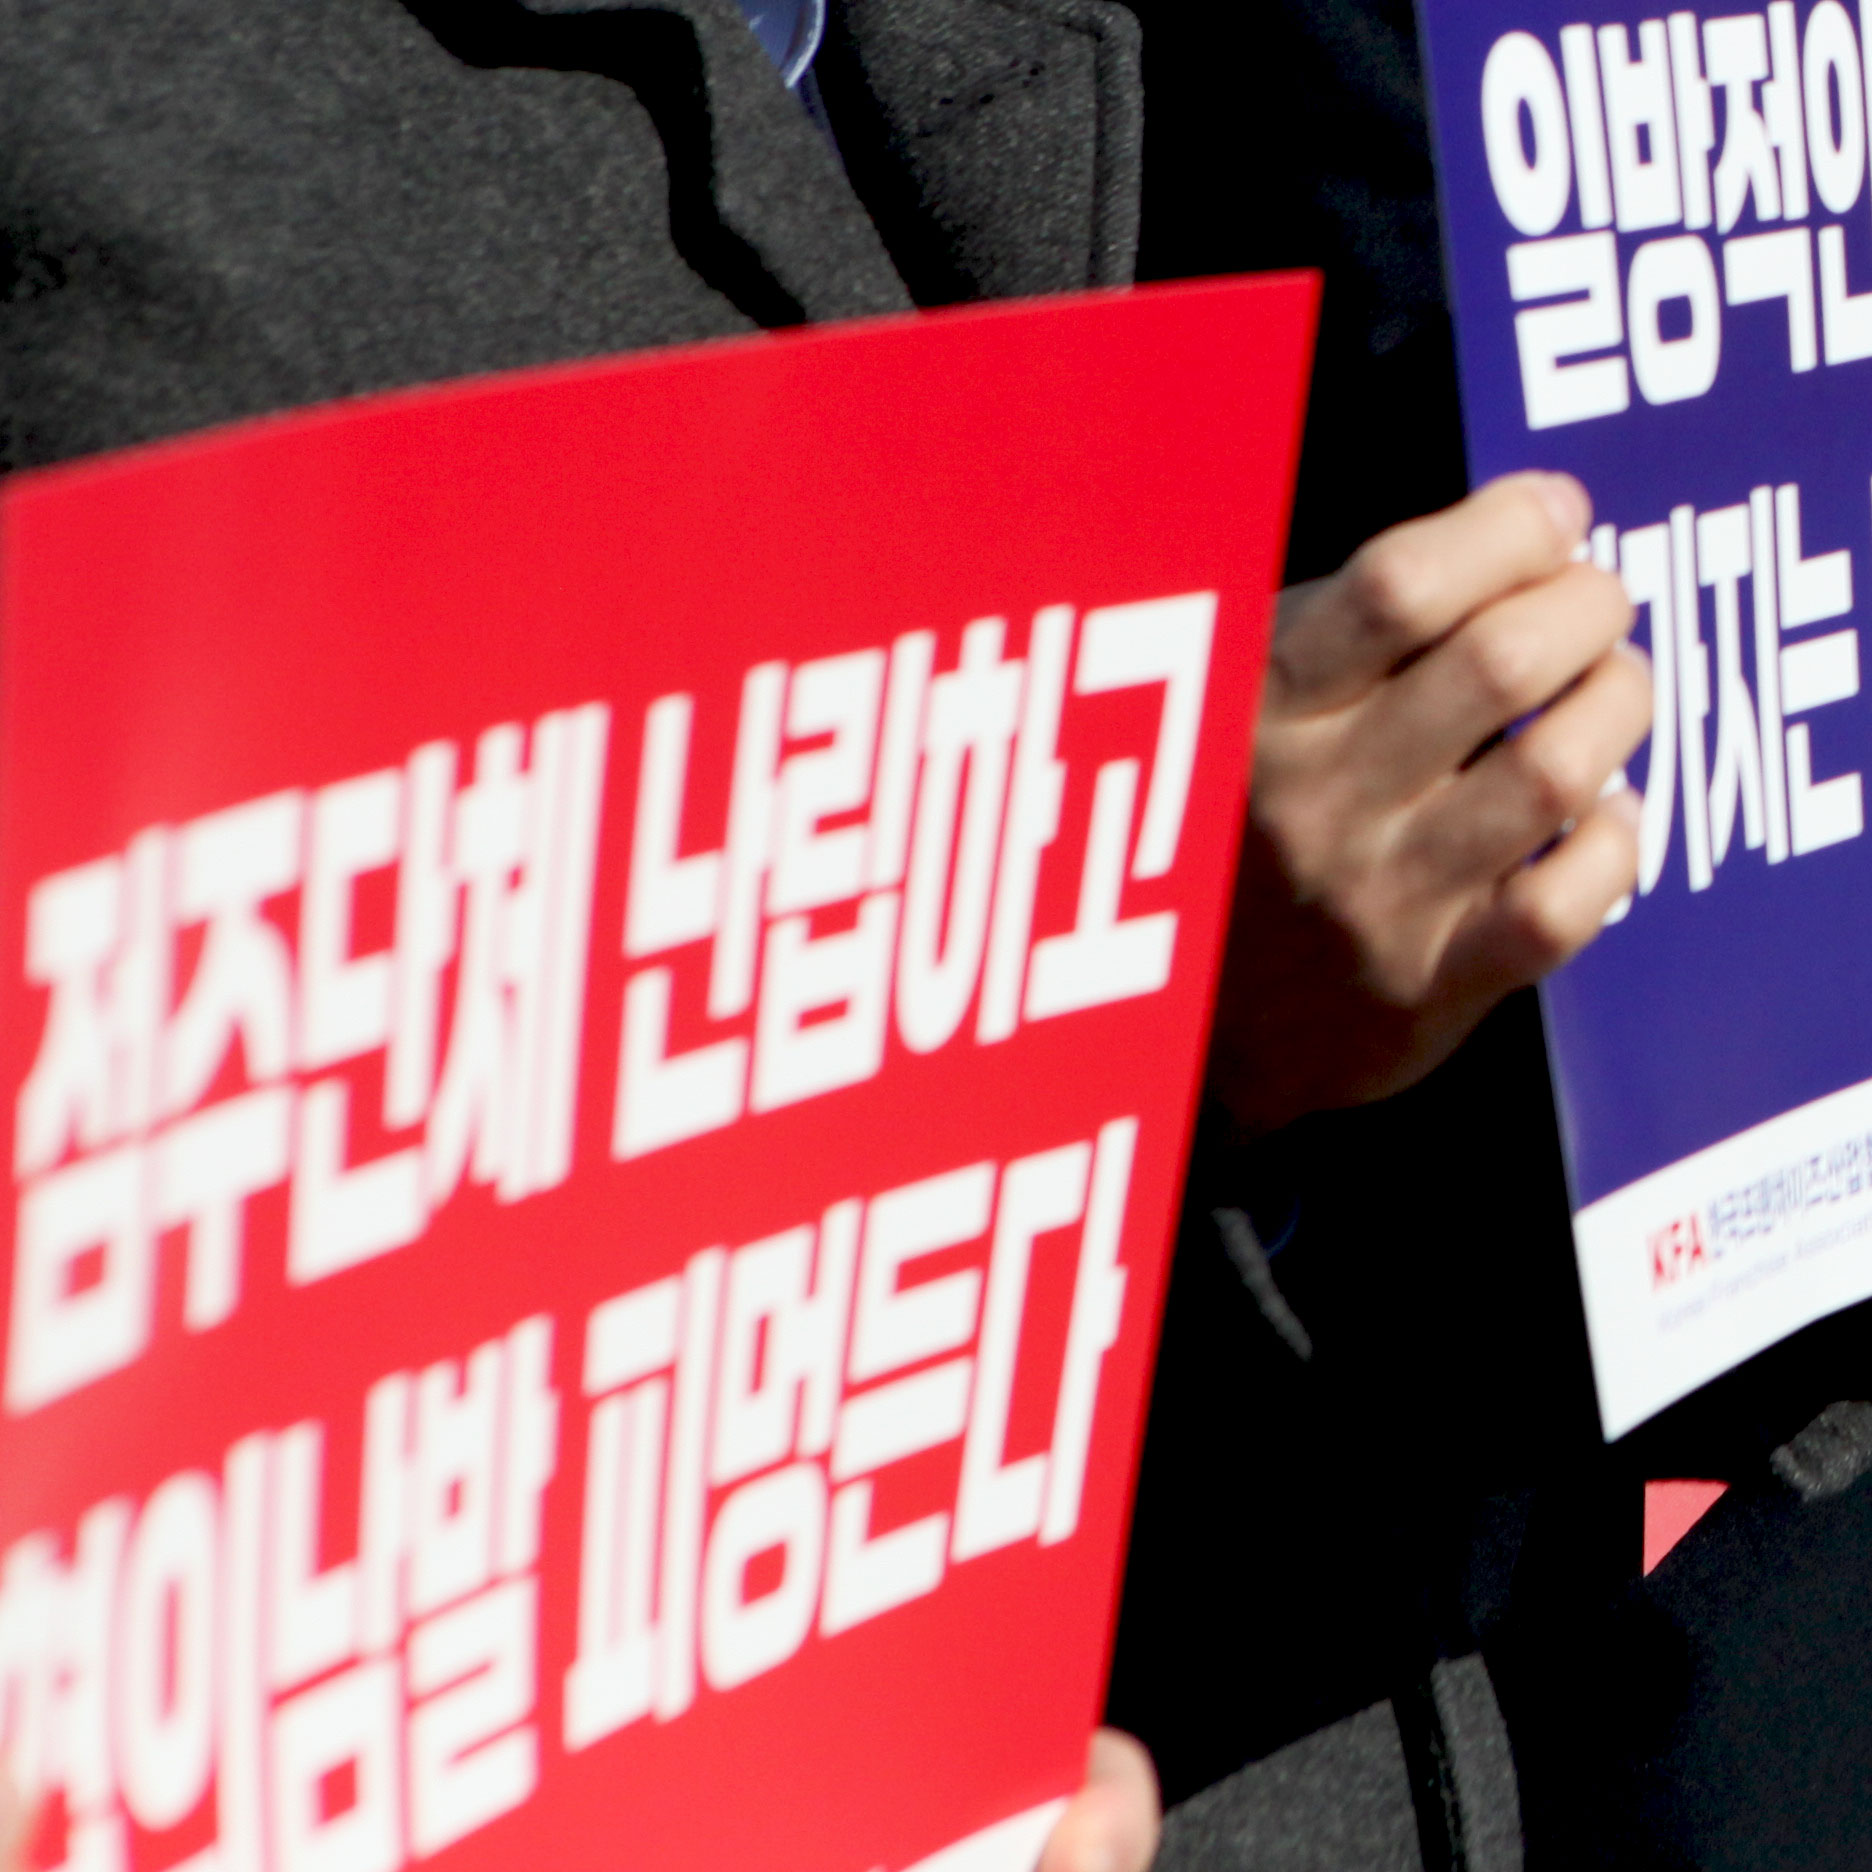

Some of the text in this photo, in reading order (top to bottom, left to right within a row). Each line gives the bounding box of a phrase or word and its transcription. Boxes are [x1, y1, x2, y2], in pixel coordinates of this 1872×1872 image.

[10, 588, 1219, 1415] 점주단체 난립하고
[1587, 482, 1864, 927] 가지는
[563, 1116, 1139, 1753] 피멍든다
